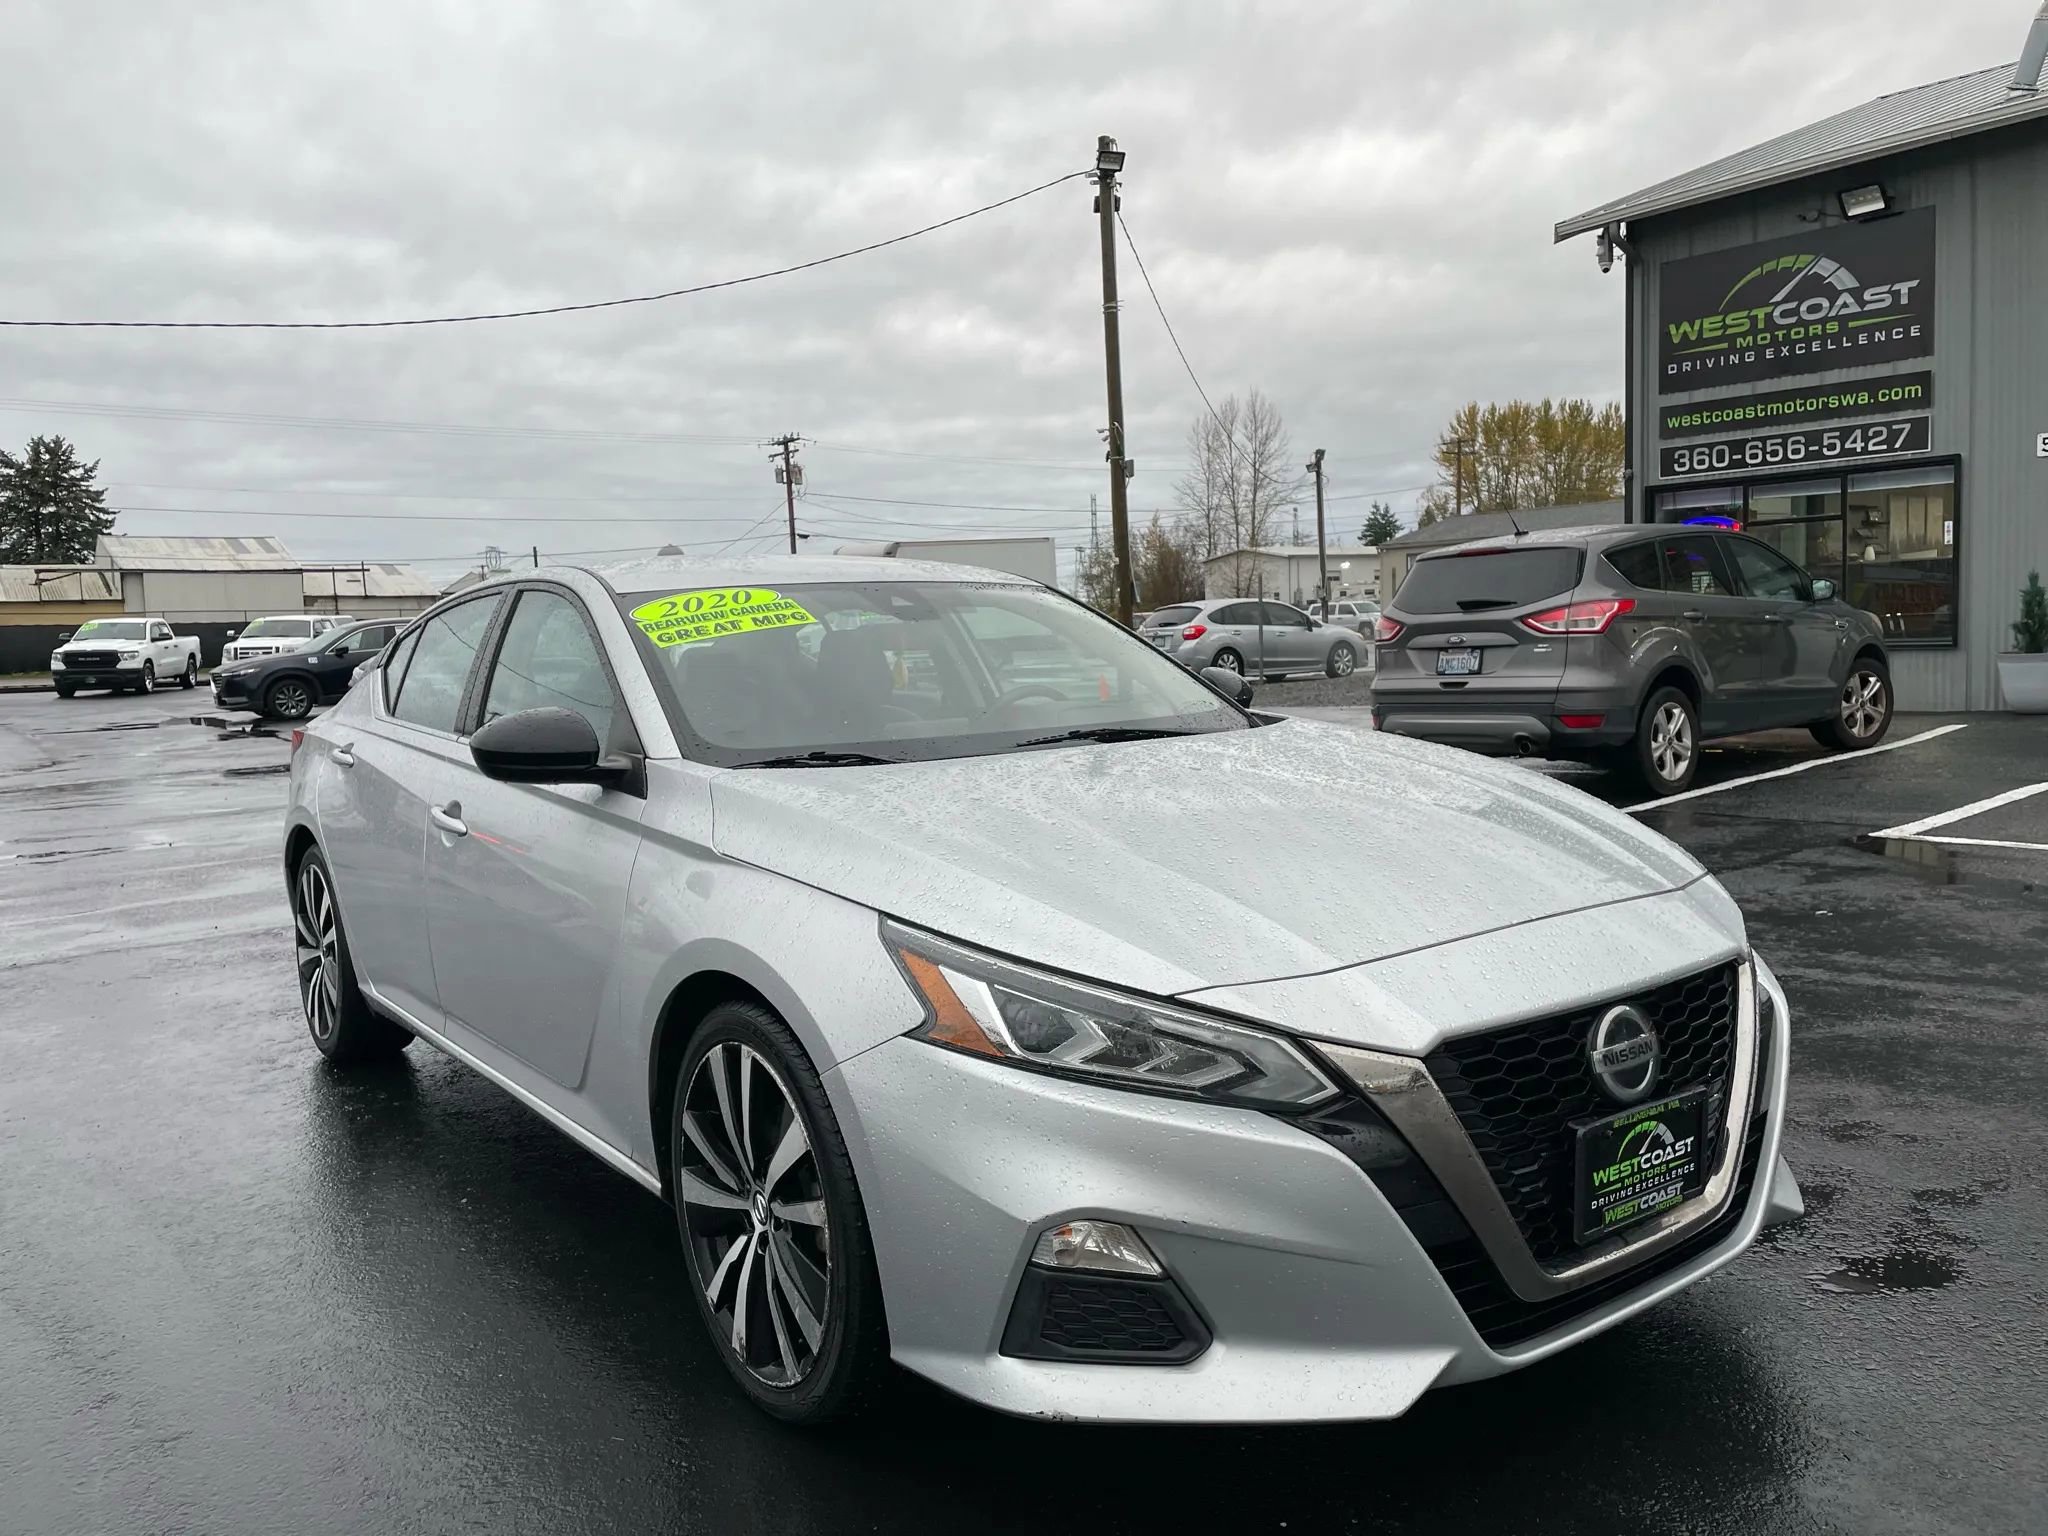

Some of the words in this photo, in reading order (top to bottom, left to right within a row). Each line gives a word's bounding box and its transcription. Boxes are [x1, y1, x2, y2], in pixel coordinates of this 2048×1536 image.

[1668, 279, 1920, 343] WESTCOAST
[1667, 351, 1755, 374] DRIVING
[1765, 325, 1921, 359] EXCELLENCE
[1736, 321, 1840, 348] MOTORS
[1667, 384, 1922, 429] westcoastmotorswa.com
[1673, 423, 1912, 472] 360-656-5427
[642, 609, 725, 633] REARVIEW
[730, 600, 795, 617] CAMERA
[659, 590, 752, 618] 2020
[656, 619, 743, 644] GREAT
[752, 611, 809, 628] MPG
[1602, 1039, 1653, 1067] NISSAN
[1593, 1136, 1695, 1186] WESTCOAST
[1624, 1164, 1667, 1187] MOTORS
[1591, 1187, 1633, 1209] DRIVING
[1635, 1163, 1695, 1192] EXCELLENCE
